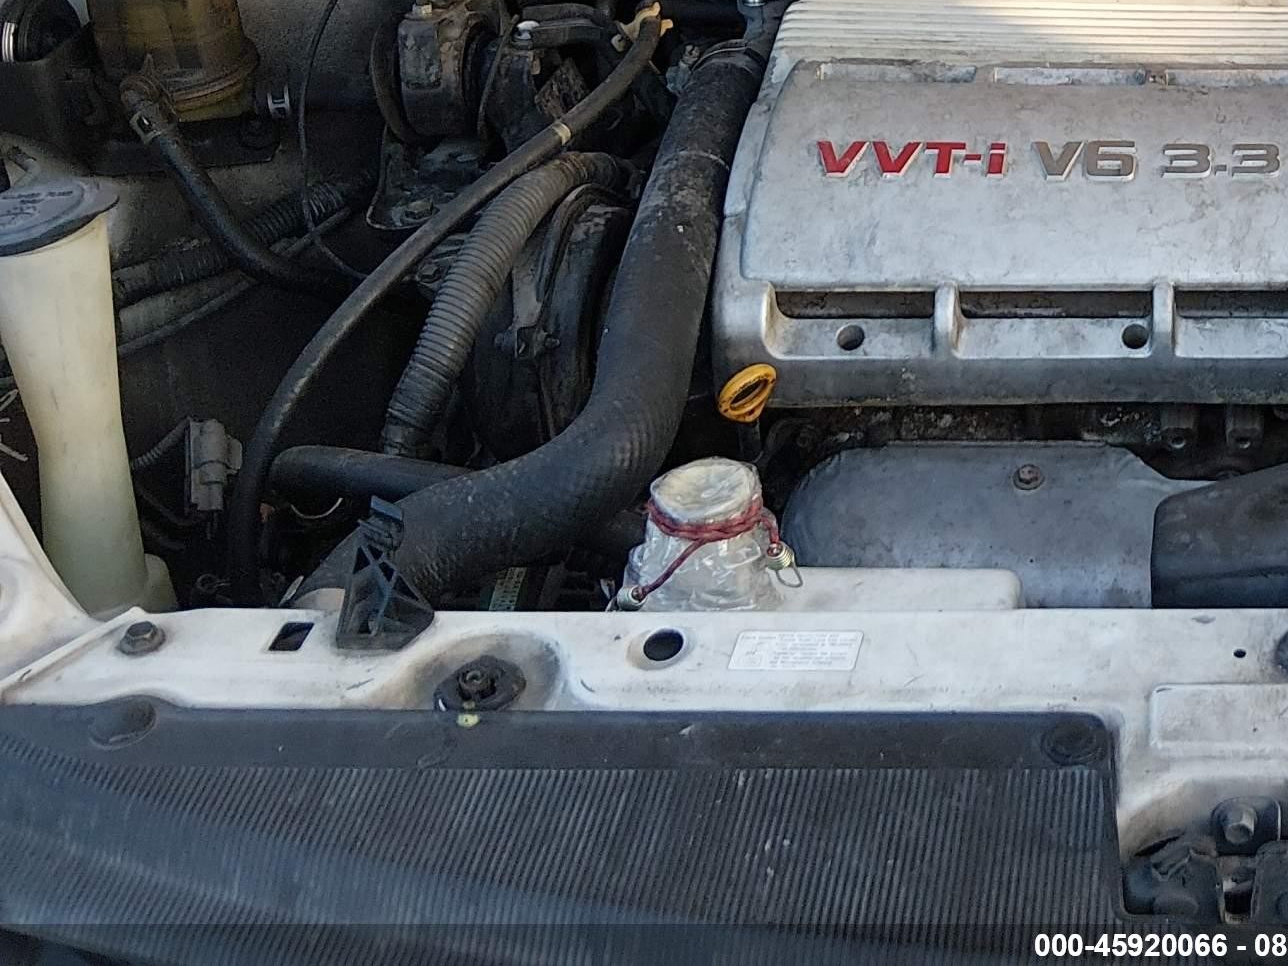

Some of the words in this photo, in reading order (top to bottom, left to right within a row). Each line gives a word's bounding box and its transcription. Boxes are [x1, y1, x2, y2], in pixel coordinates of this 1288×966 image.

[816, 139, 1010, 179] VVT-i
[1030, 140, 1139, 182] V6
[1161, 142, 1282, 180] 3.3
